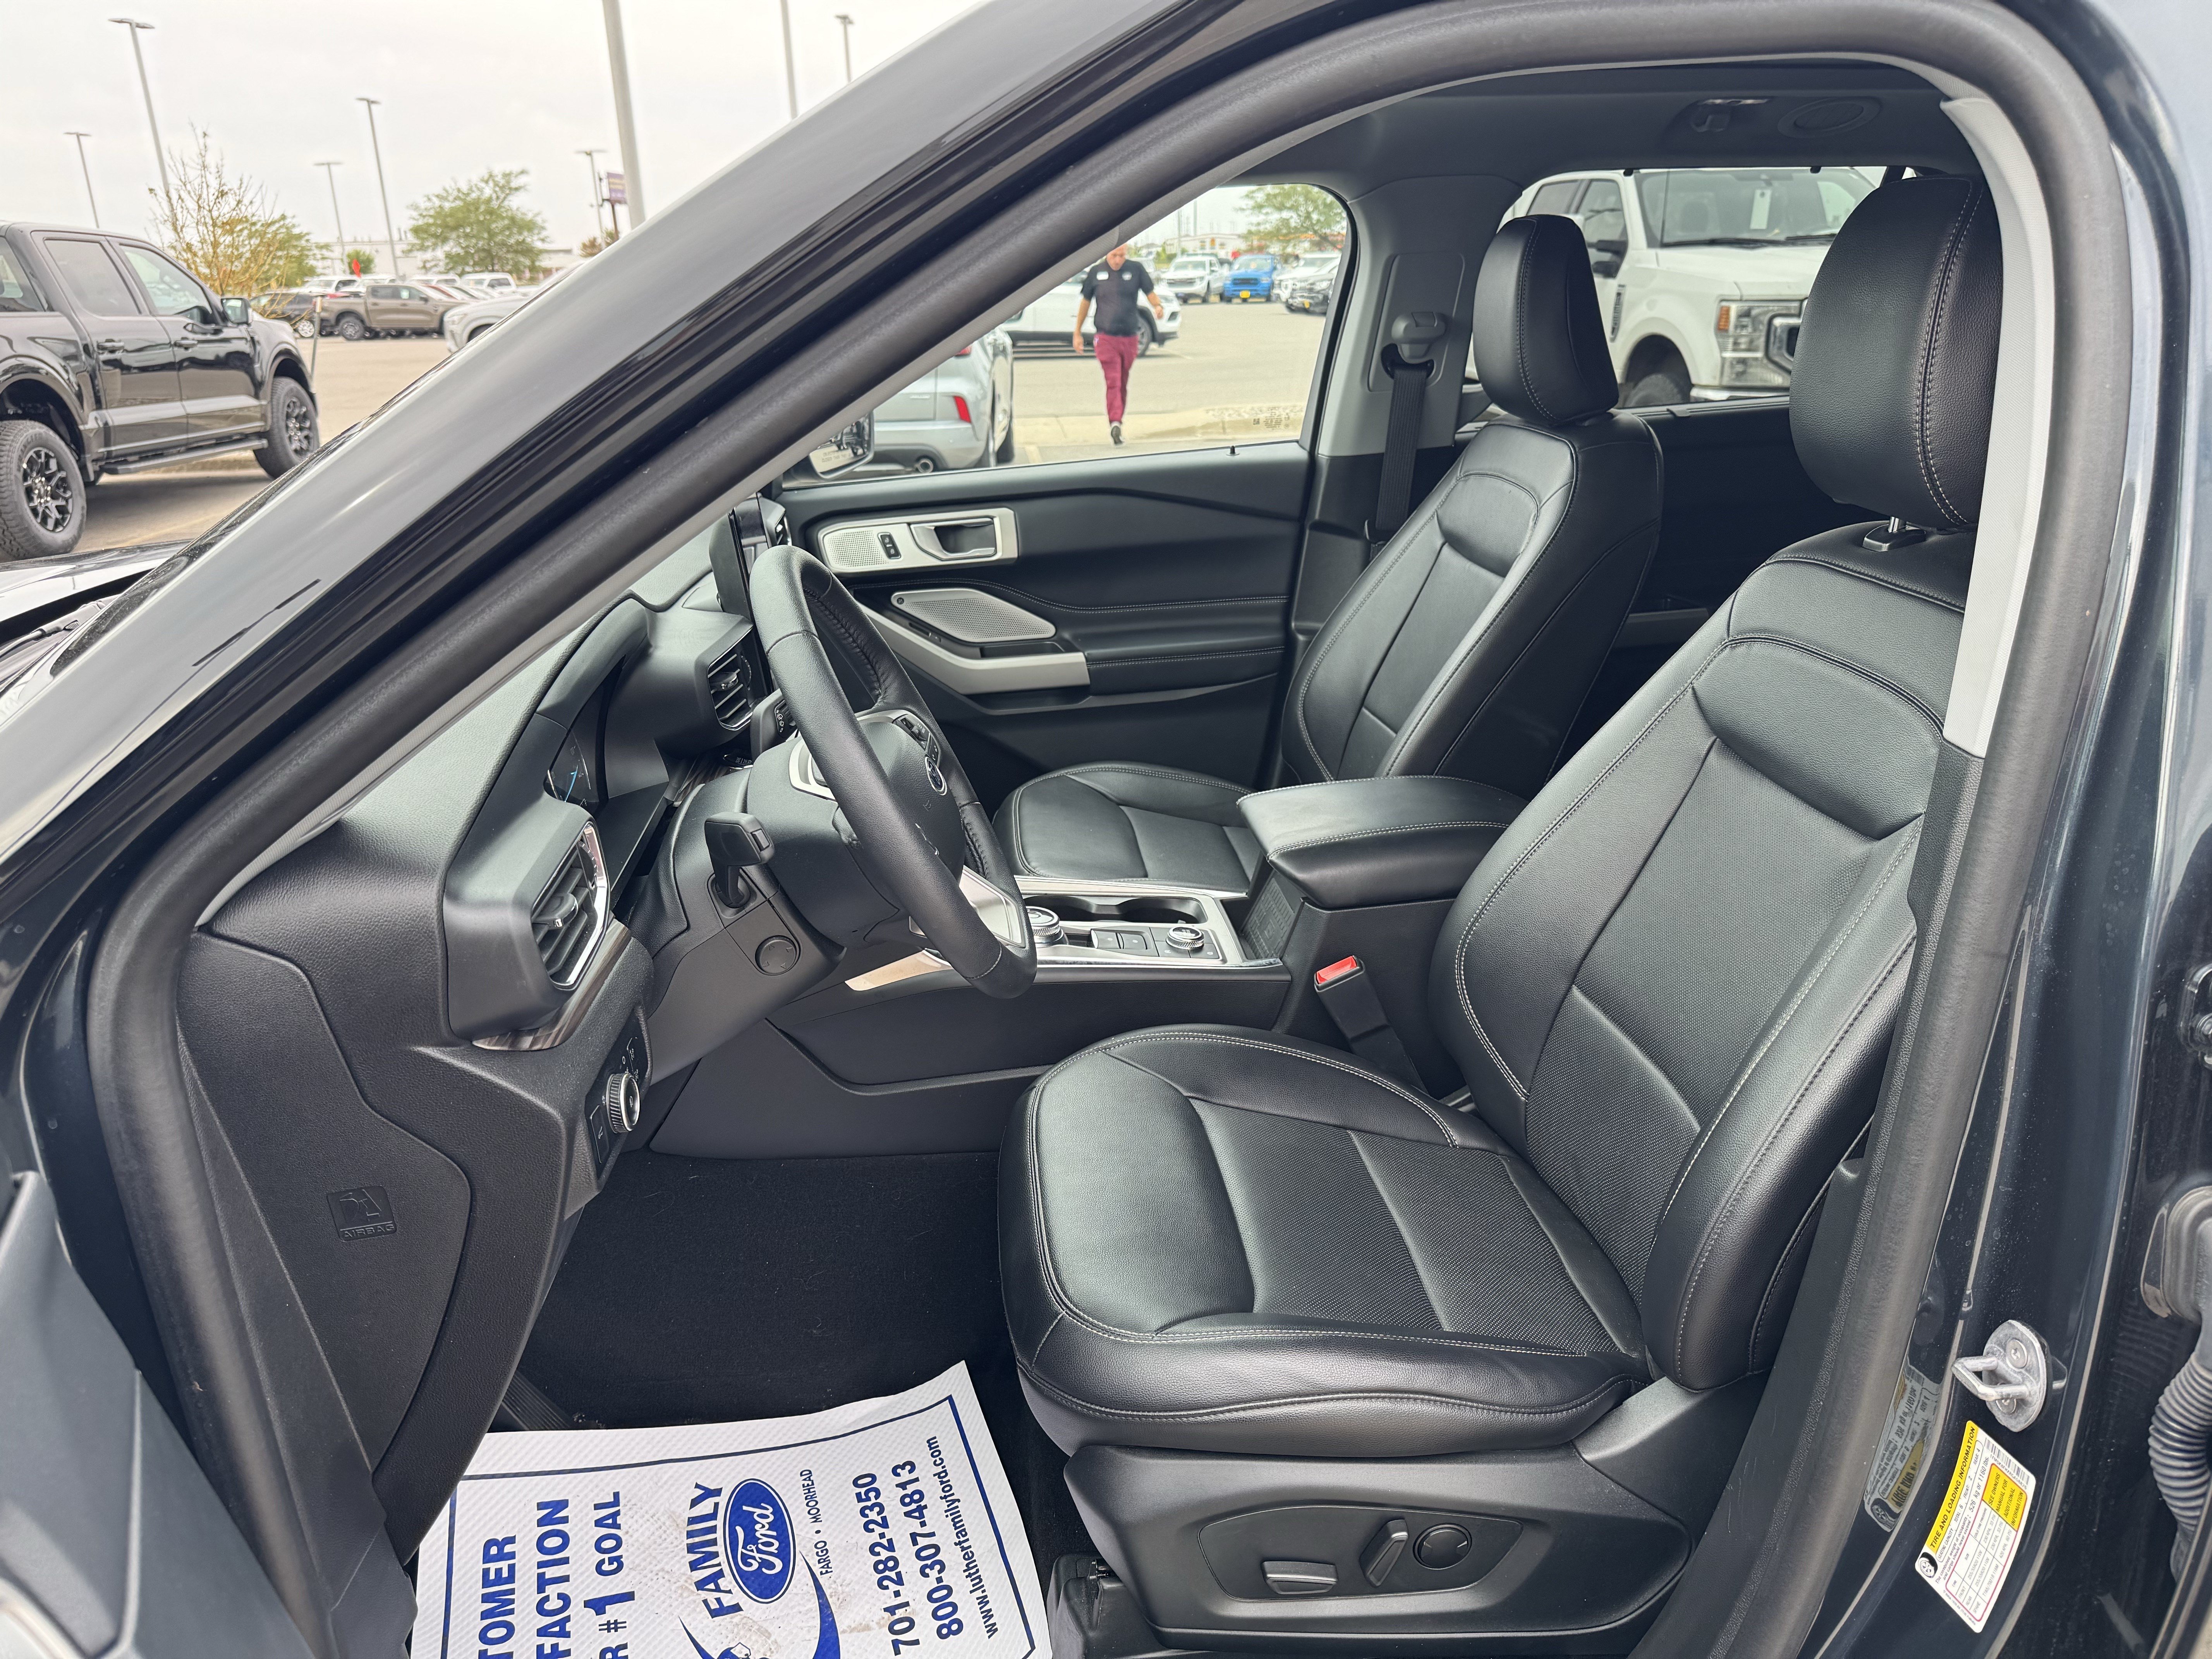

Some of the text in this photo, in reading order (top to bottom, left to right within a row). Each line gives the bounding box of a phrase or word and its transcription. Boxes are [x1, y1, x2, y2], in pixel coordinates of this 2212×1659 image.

[343, 1224, 395, 1238] AIRBAG
[1930, 1426, 1975, 1549] TIRE AND LOADING INFORMATION
[1973, 1489, 1980, 1498] kg
[1991, 1472, 2000, 1495] OWNERS
[1996, 1490, 2005, 1512] MANUAL
[2003, 1486, 2015, 1518] ADDITIONAL
[2011, 1491, 2023, 1527] INFORMATION
[594, 1491, 624, 1577] GOAL
[686, 1482, 744, 1619] FAMILY
[735, 1503, 783, 1575] Ford
[800, 1469, 833, 1576] FARGO MOORHEAD
[891, 1460, 963, 1640] 800-307-4813
[926, 1436, 998, 1639] www.lutherfamilyford.com
[1937, 1544, 1946, 1559] SEATING
[1944, 1528, 1953, 1545] CAPACITY
[536, 1499, 571, 1659] FACTION
[852, 1473, 920, 1656] 701-282-2350
[1940, 1556, 1950, 1576] combined
